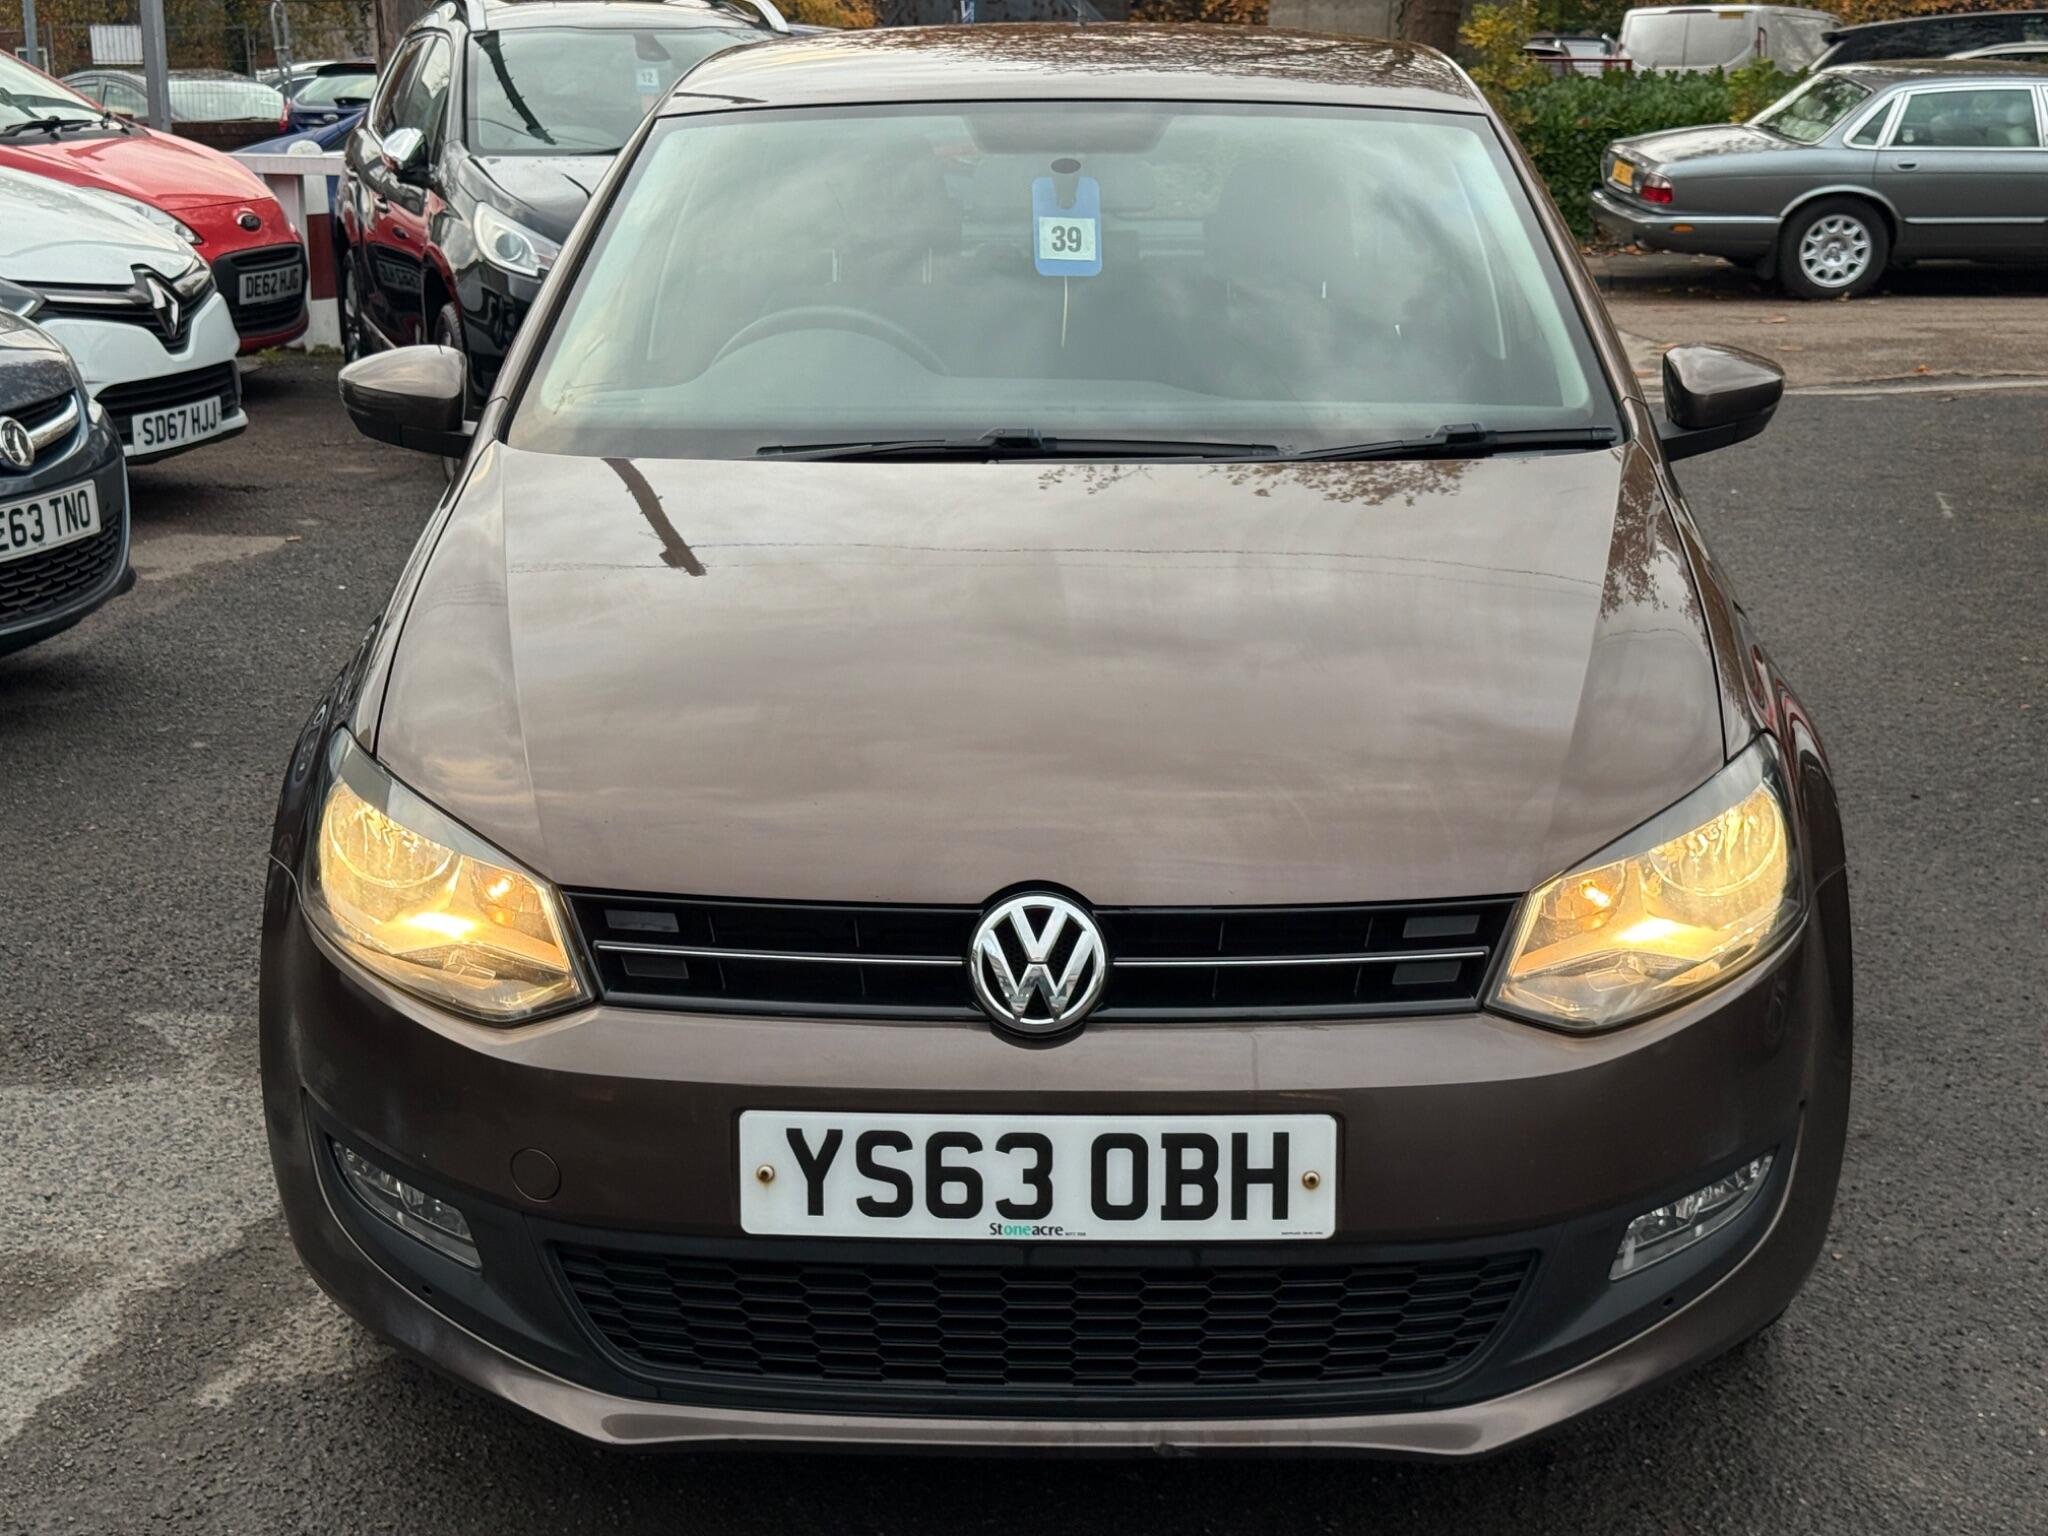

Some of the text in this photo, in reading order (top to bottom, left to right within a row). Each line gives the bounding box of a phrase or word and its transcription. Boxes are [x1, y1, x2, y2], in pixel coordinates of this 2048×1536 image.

[1051, 225, 1082, 252] 39
[246, 272, 278, 299] DE62
[142, 401, 217, 446] SD67 HJJ
[49, 489, 91, 537] TNO
[786, 1127, 1290, 1221] YS63 OBH
[989, 1222, 1064, 1236] Stoneacre
